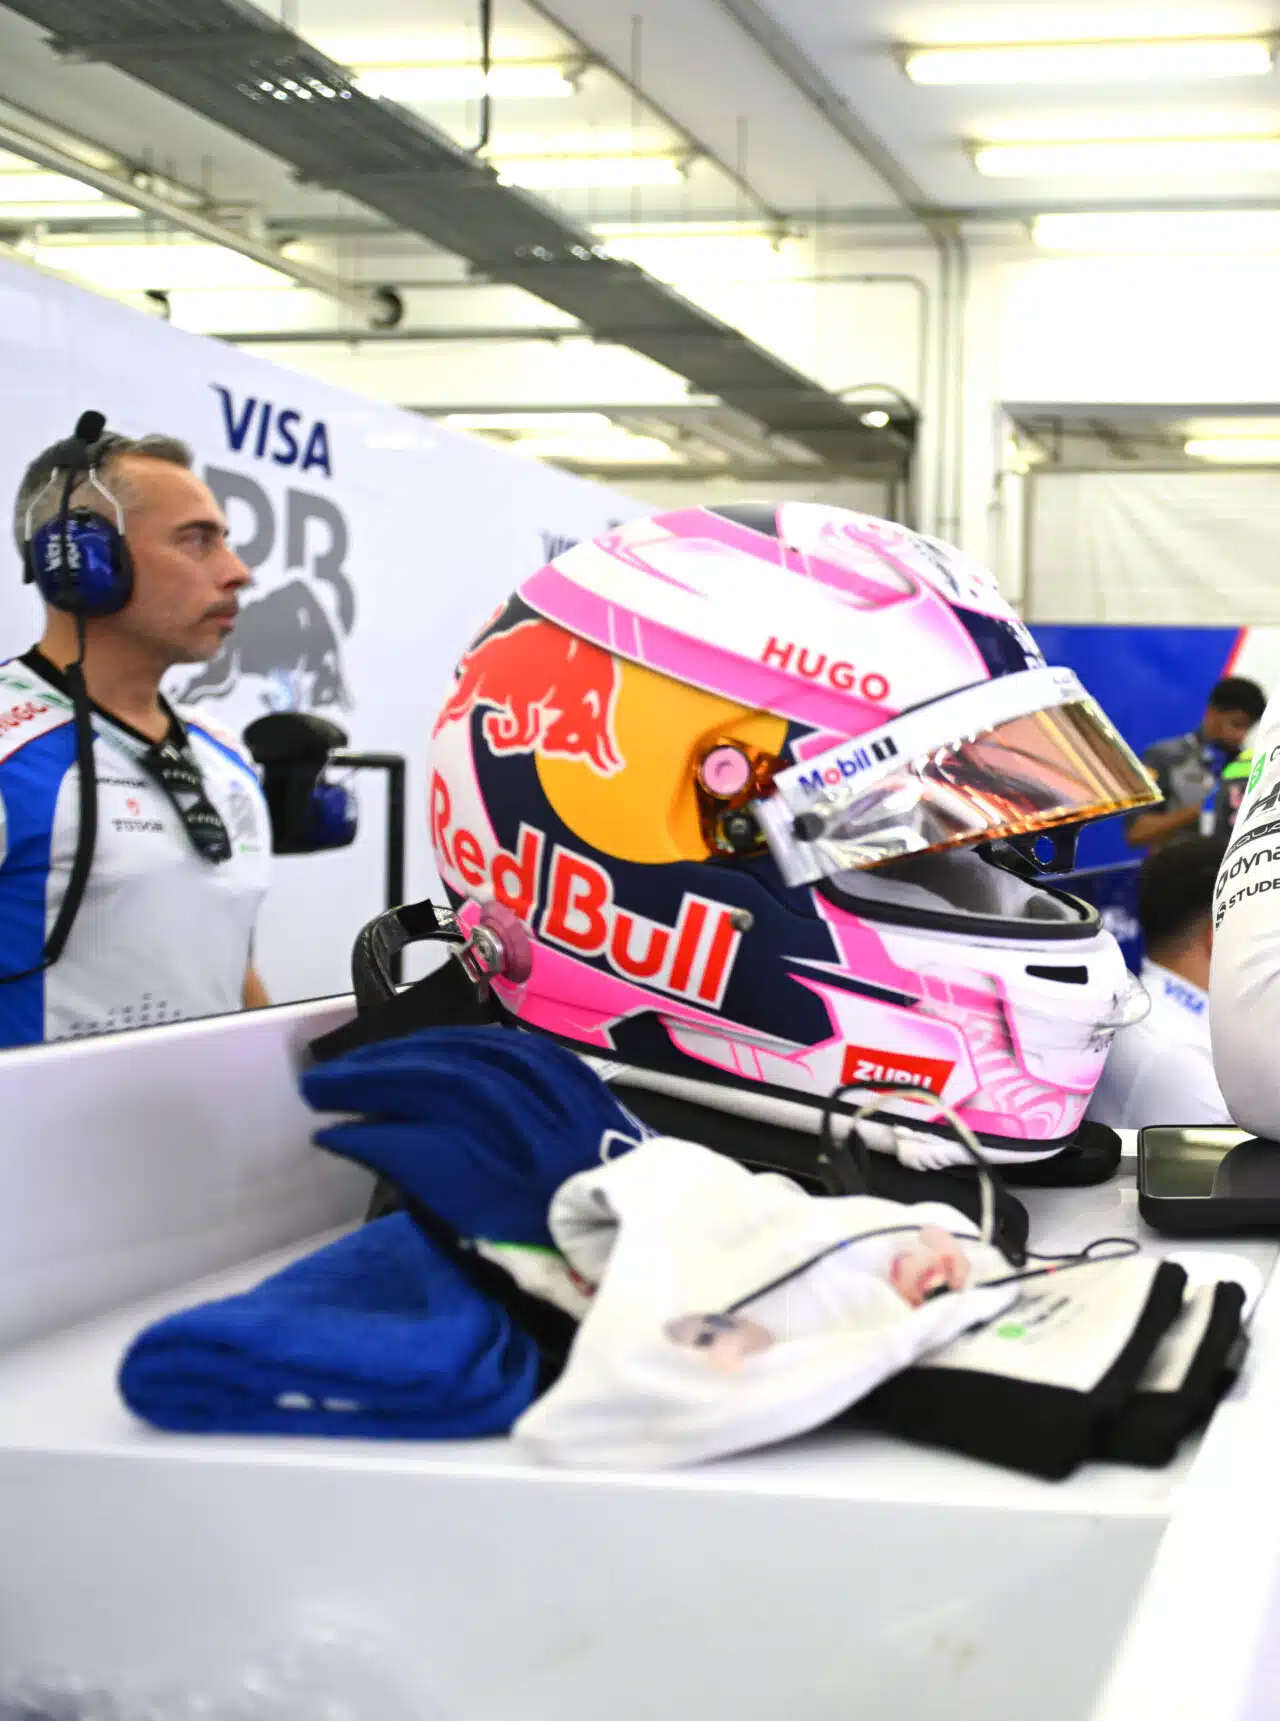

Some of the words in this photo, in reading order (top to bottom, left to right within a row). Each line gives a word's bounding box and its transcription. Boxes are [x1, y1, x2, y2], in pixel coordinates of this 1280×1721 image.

[209, 384, 332, 478] VISA
[761, 635, 891, 702] HUGO
[798, 747, 873, 794] Mobil
